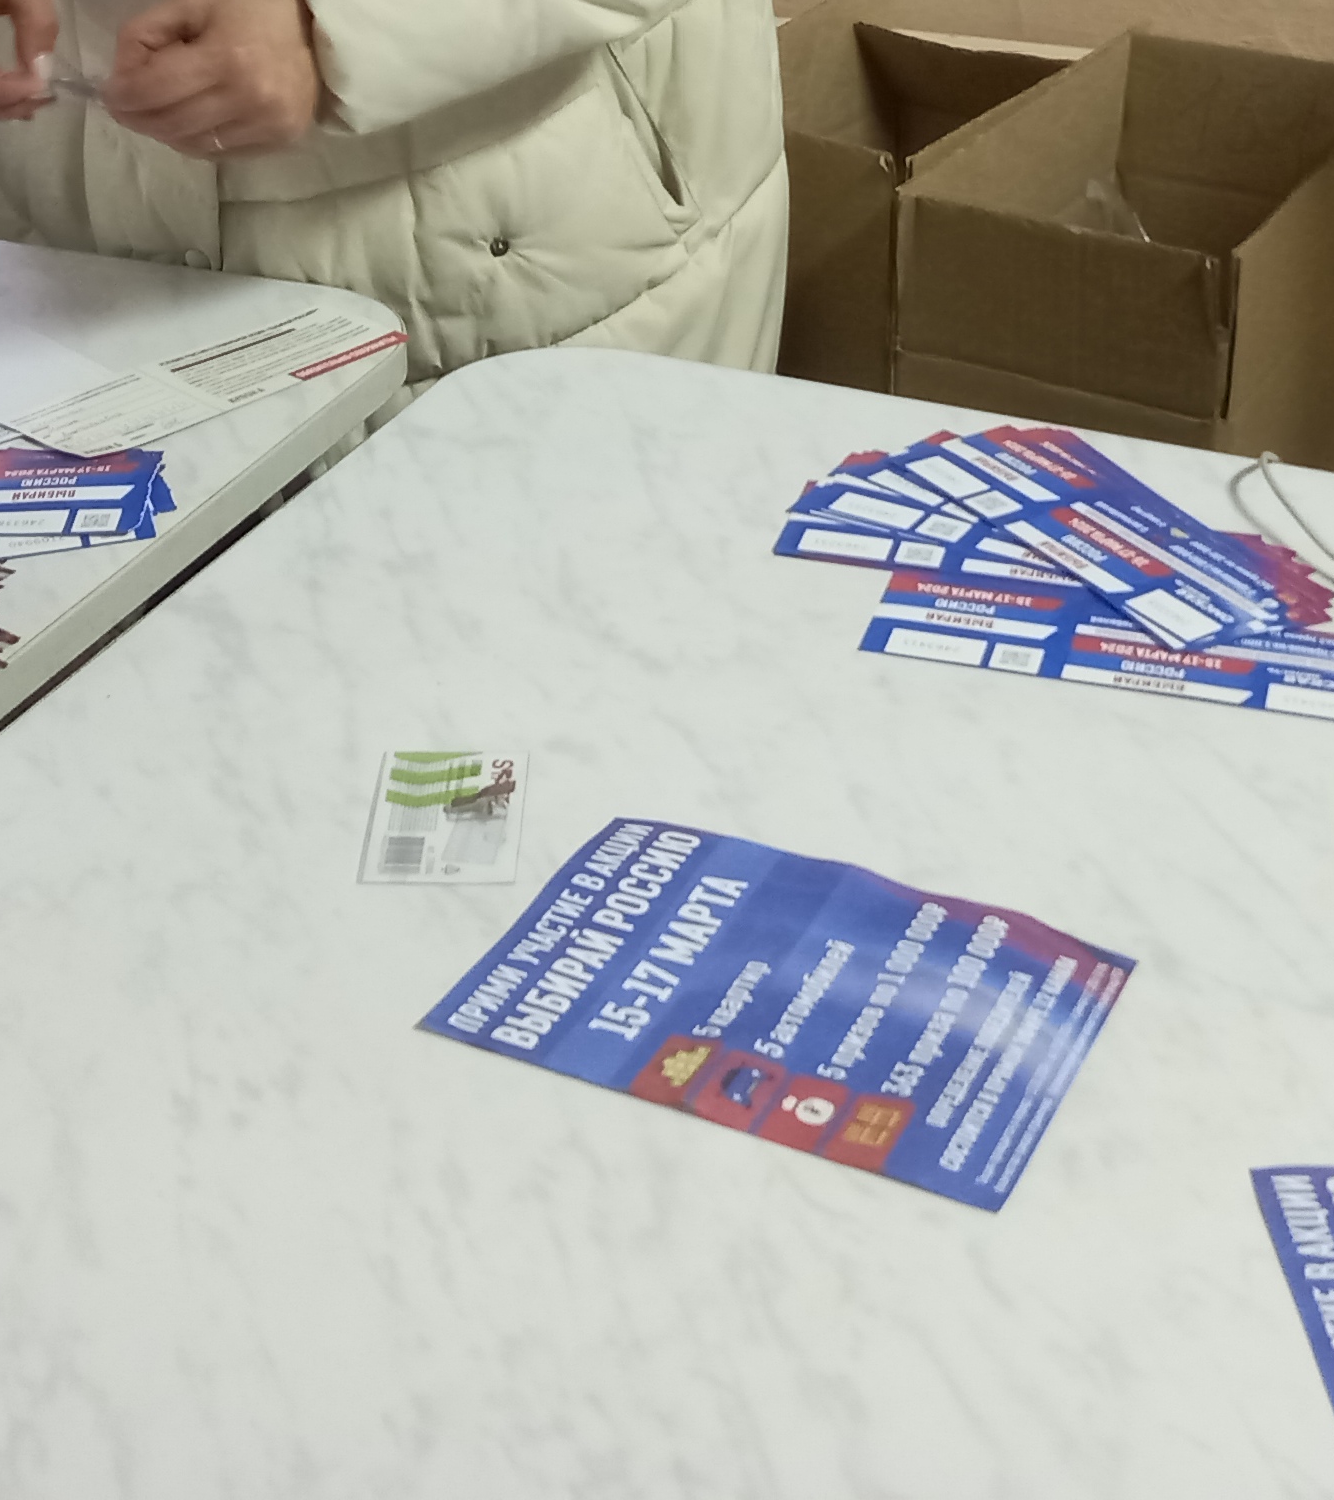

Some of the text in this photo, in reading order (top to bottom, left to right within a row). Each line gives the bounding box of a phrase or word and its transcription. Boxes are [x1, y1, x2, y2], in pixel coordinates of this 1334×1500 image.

[20, 475, 77, 486] РОССИЮ
[447, 822, 654, 1033] ПРИМИ УЧАСТИЕ В АКЦИИ
[490, 830, 701, 1050] ВЫБИРАЙ РОССИЮ
[587, 875, 748, 1041] 15-17 МАРТА
